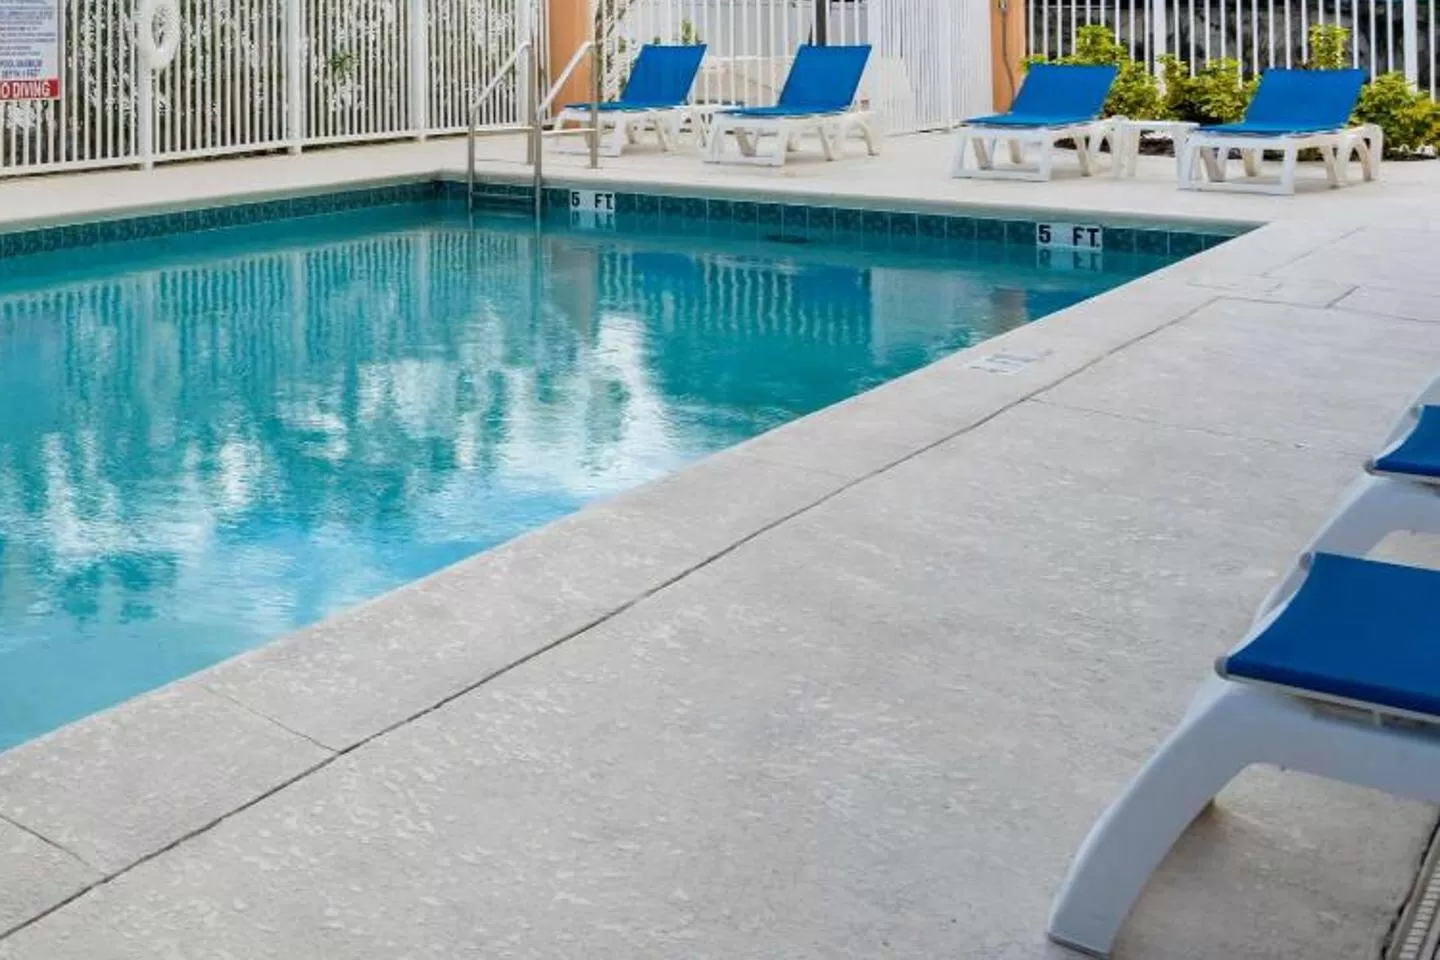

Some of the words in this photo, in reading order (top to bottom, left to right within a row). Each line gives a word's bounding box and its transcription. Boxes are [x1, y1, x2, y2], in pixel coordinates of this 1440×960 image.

[12, 81, 51, 98] DIVING
[571, 191, 580, 208] 5
[1038, 224, 1051, 244] 5
